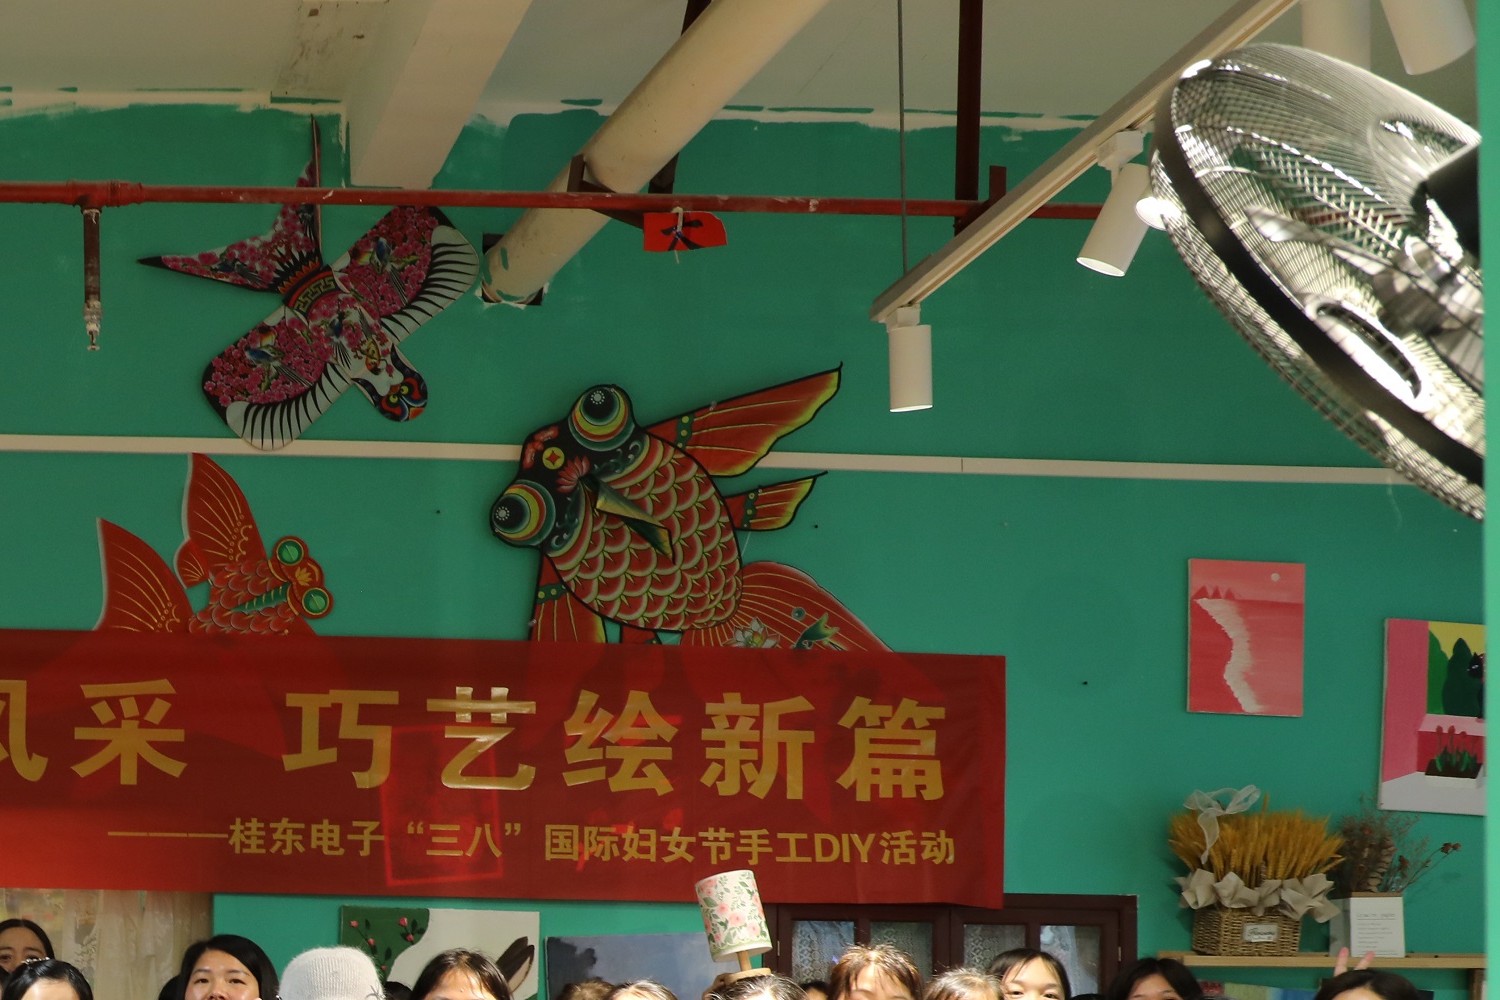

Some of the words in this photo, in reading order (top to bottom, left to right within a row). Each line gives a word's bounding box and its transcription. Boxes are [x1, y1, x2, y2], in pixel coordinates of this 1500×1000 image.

[281, 685, 948, 802] 巧艺绘新篇
